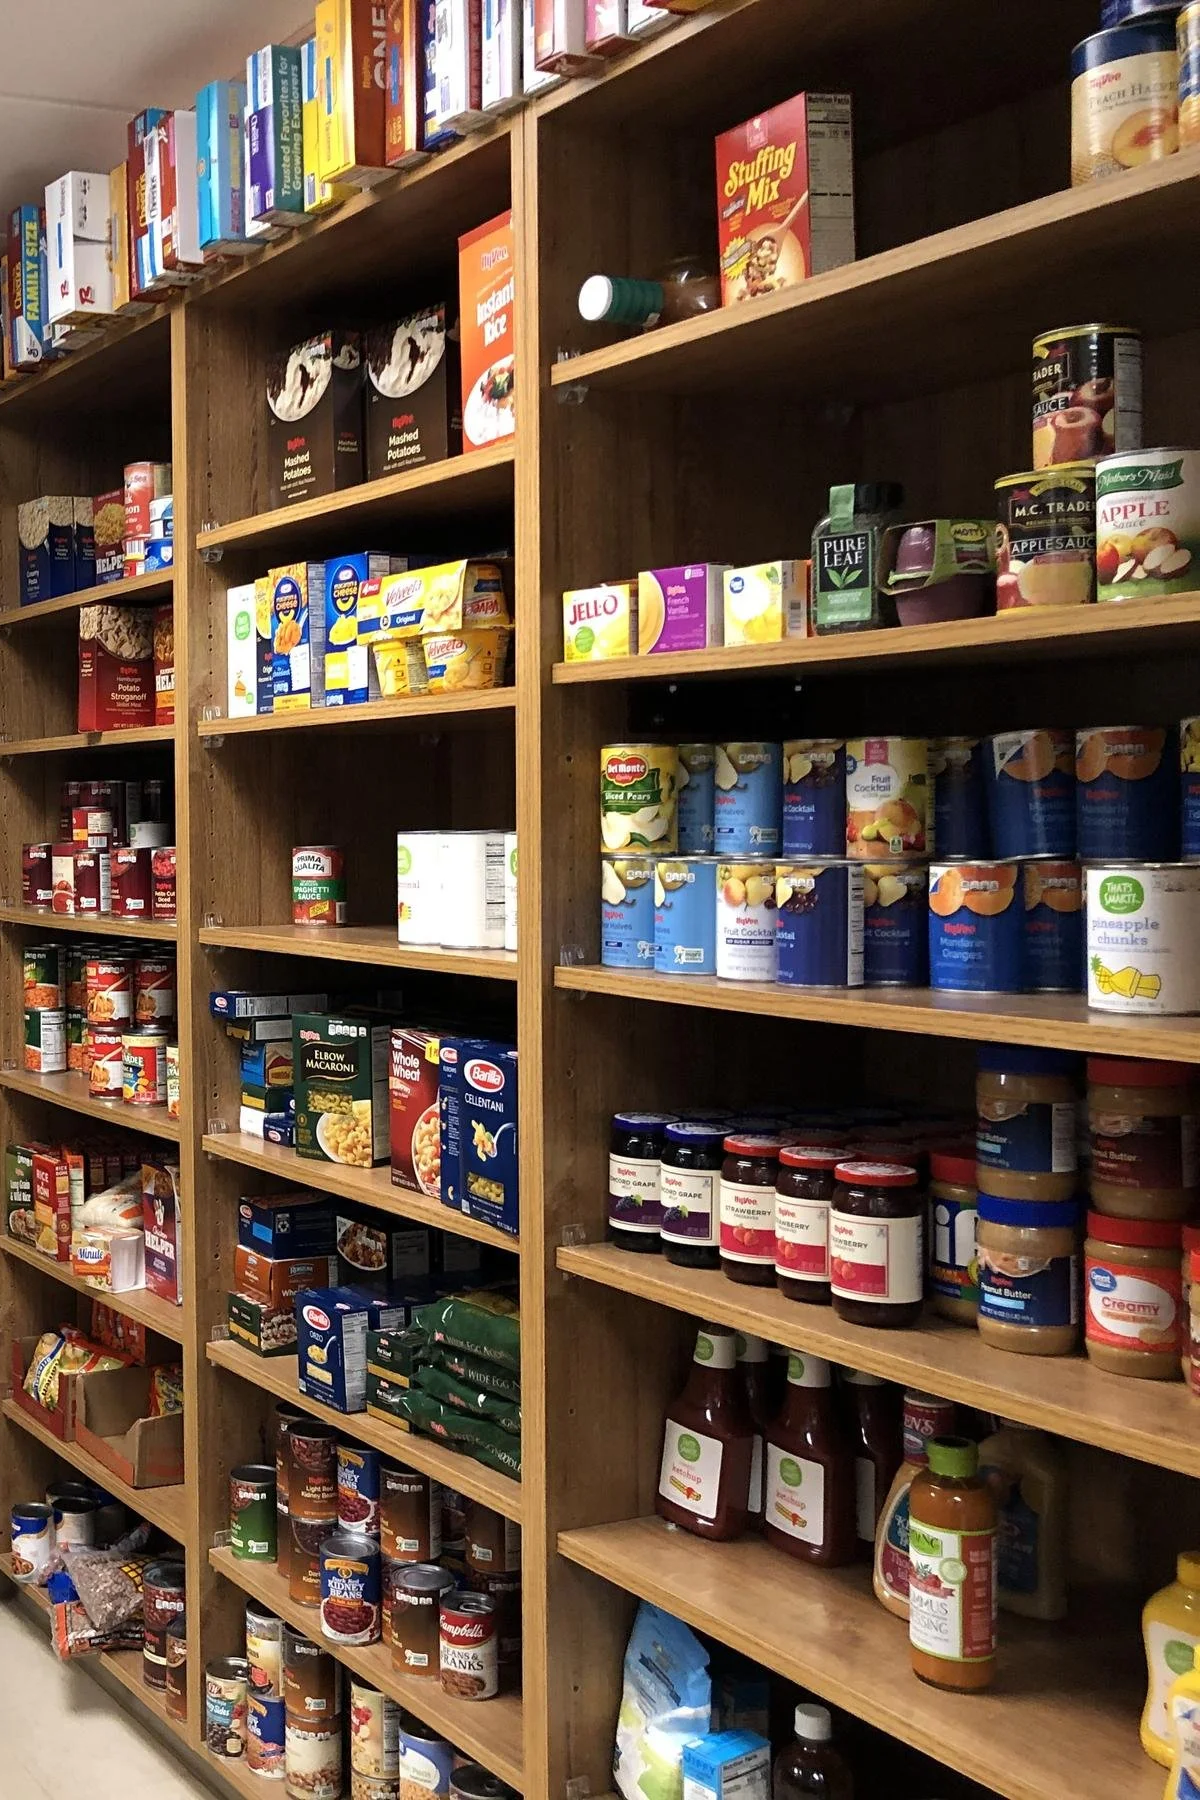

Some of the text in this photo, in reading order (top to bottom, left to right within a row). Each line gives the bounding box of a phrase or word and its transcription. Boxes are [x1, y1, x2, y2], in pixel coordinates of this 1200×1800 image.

[278, 55, 291, 197] Trusted Favorites for
[290, 65, 301, 191] Growing Explorers
[724, 142, 797, 197] Stuffing
[746, 178, 781, 215] Mix
[25, 221, 40, 321] FAMILY SIZE
[476, 276, 514, 328] Instant
[484, 313, 507, 347] Rice
[388, 428, 419, 448] Mashed
[386, 442, 421, 462] Potatoes
[284, 451, 310, 469] Mashed
[283, 464, 312, 482] Potatoes
[1099, 471, 1138, 490] Mother's
[1138, 466, 1174, 486] Maid
[1015, 504, 1043, 517] M.C.
[1099, 500, 1170, 525] APPLE
[1112, 517, 1147, 530] Sauce
[824, 536, 867, 555] PURE
[824, 551, 863, 568] LEAF
[385, 579, 422, 607] Velveeta
[396, 613, 416, 625] Original
[117, 683, 141, 694] Potato
[110, 692, 147, 703] Stroganoff
[619, 762, 646, 775] Monte
[871, 774, 892, 785] Fruit
[853, 782, 892, 794] Cocktail
[627, 792, 651, 801] Pears
[296, 854, 322, 867] PRIMA
[1105, 881, 1133, 893] THAT'S
[297, 893, 322, 901] SAUCE
[1091, 917, 1161, 933] pineapple
[723, 928, 777, 937] Fruit Cocktail
[1096, 933, 1149, 946] chunks
[314, 1049, 345, 1062] ELBOW
[392, 1050, 421, 1069] Whole
[305, 1057, 355, 1074] MACARONI
[392, 1062, 421, 1082] Wheat
[471, 1064, 503, 1087] Barilla
[464, 1092, 504, 1114] CELLENTANI
[1108, 1150, 1138, 1163] Butter
[36, 1168, 50, 1182] RICE
[632, 1180, 657, 1189] GRAPE
[678, 1191, 703, 1200] GRAPE
[724, 1204, 772, 1217] STRAWBERRY
[144, 1229, 176, 1261] HELPER
[78, 1247, 104, 1261] Minute
[1004, 1288, 1032, 1301] Butter
[1101, 1296, 1160, 1318] Creamy
[308, 1310, 329, 1328] Barilla
[309, 1330, 324, 1343] ORZO
[467, 1369, 491, 1384] WIDE
[672, 1463, 703, 1485] ketchup
[300, 1490, 319, 1501] Kidney
[305, 1484, 334, 1494] Light Red
[775, 1490, 806, 1511] ketchup
[328, 1580, 366, 1593] KIDNEY
[329, 1588, 363, 1600] BEANS
[471, 1653, 479, 1662] &
